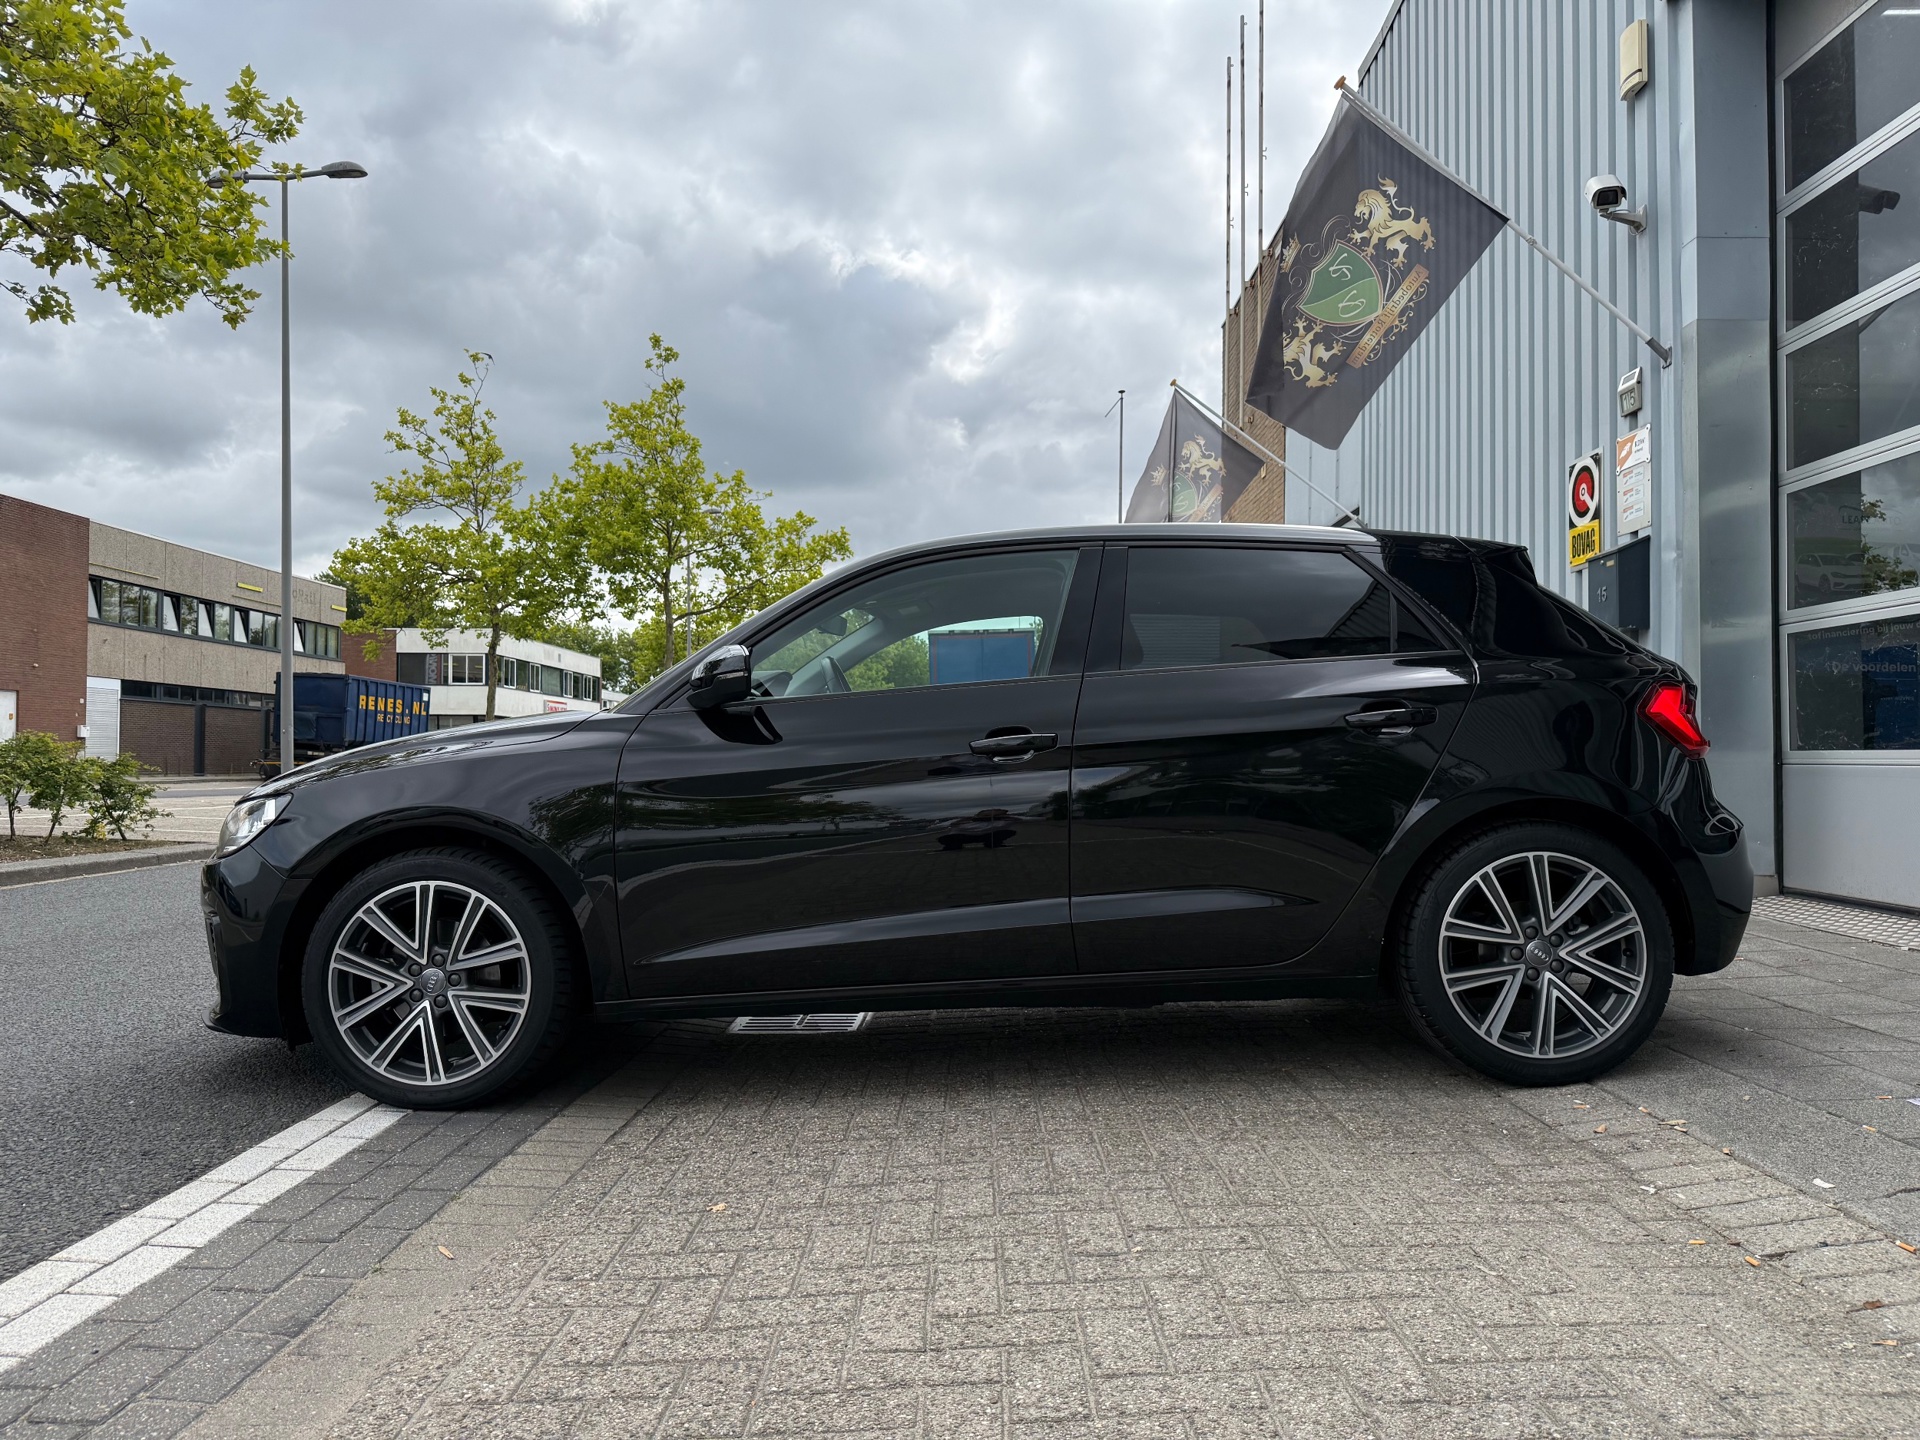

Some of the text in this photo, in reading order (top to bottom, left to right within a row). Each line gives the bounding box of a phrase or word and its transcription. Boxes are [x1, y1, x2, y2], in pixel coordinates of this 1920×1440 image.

[1623, 390, 1636, 409] 15
[1571, 527, 1596, 559] BOVAG
[1597, 585, 1607, 603] 15
[1852, 661, 1917, 673] voordelen
[359, 694, 427, 716] RENES.NL
